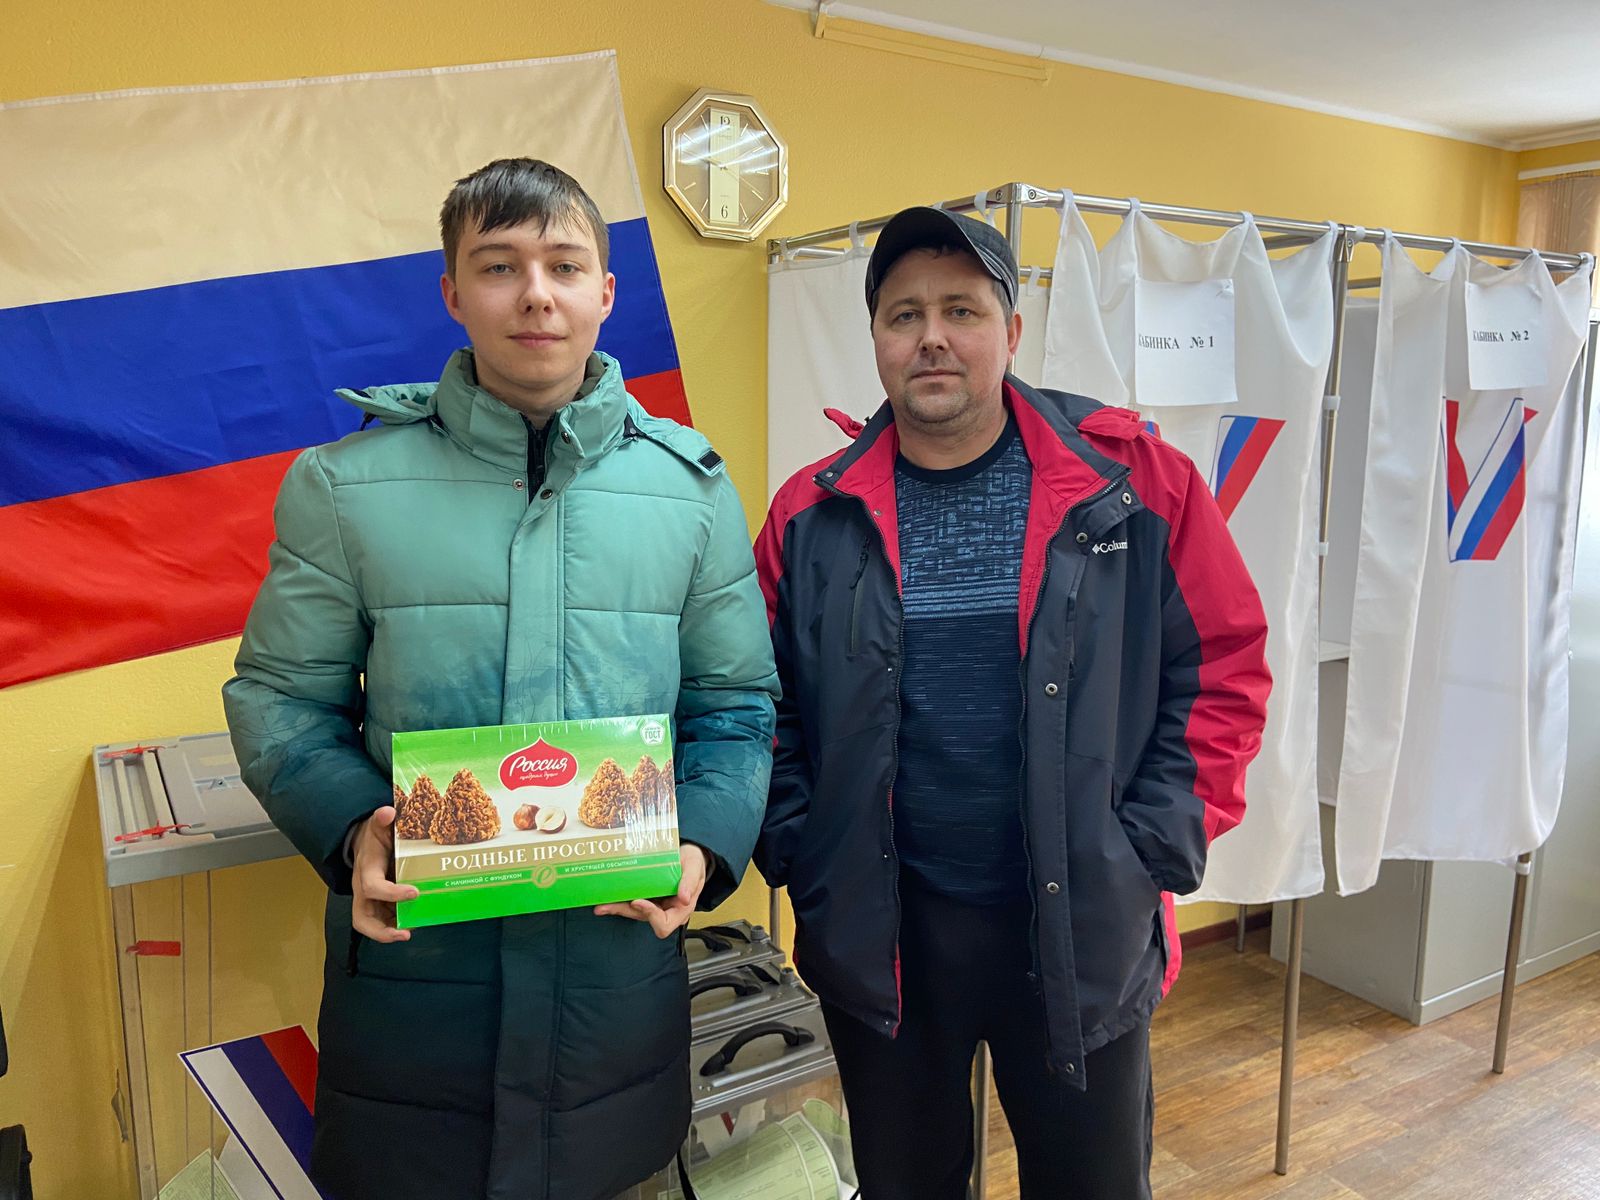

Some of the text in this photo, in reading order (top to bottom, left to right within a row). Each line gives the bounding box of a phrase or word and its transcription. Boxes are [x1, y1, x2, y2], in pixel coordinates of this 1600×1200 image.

[721, 205, 728, 219] 6
[1524, 330, 1529, 340] 2
[1190, 336, 1204, 348] №
[645, 729, 661, 737] ГОСТ
[509, 755, 568, 777] Россия
[440, 848, 527, 871] РОДНЫЕ
[451, 876, 484, 886] НАЧИНКОЙ
[490, 873, 522, 881] ФУНДУКОМ
